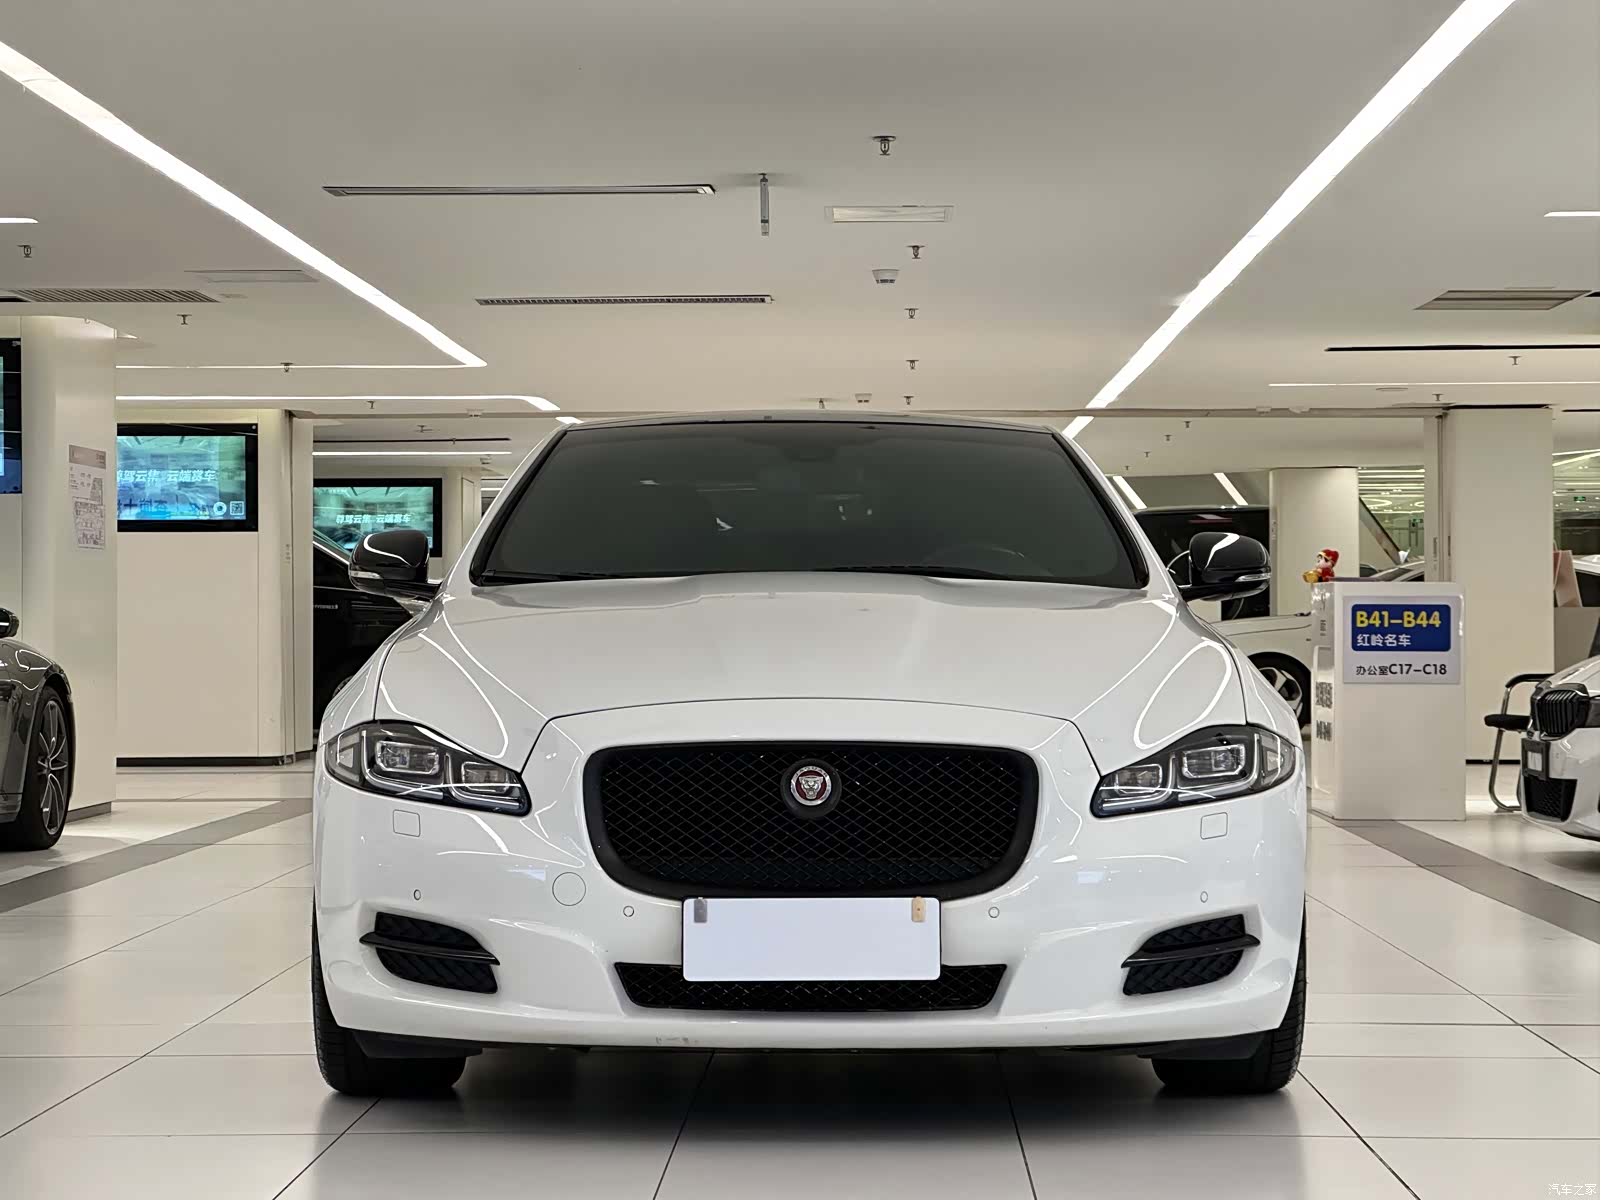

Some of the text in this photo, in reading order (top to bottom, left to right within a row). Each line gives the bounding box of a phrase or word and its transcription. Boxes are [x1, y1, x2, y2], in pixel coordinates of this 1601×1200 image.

[1356, 610, 1442, 628] B41-B44
[1356, 633, 1411, 647] 红岭名车
[1356, 663, 1447, 676] 办公室C17-C18
